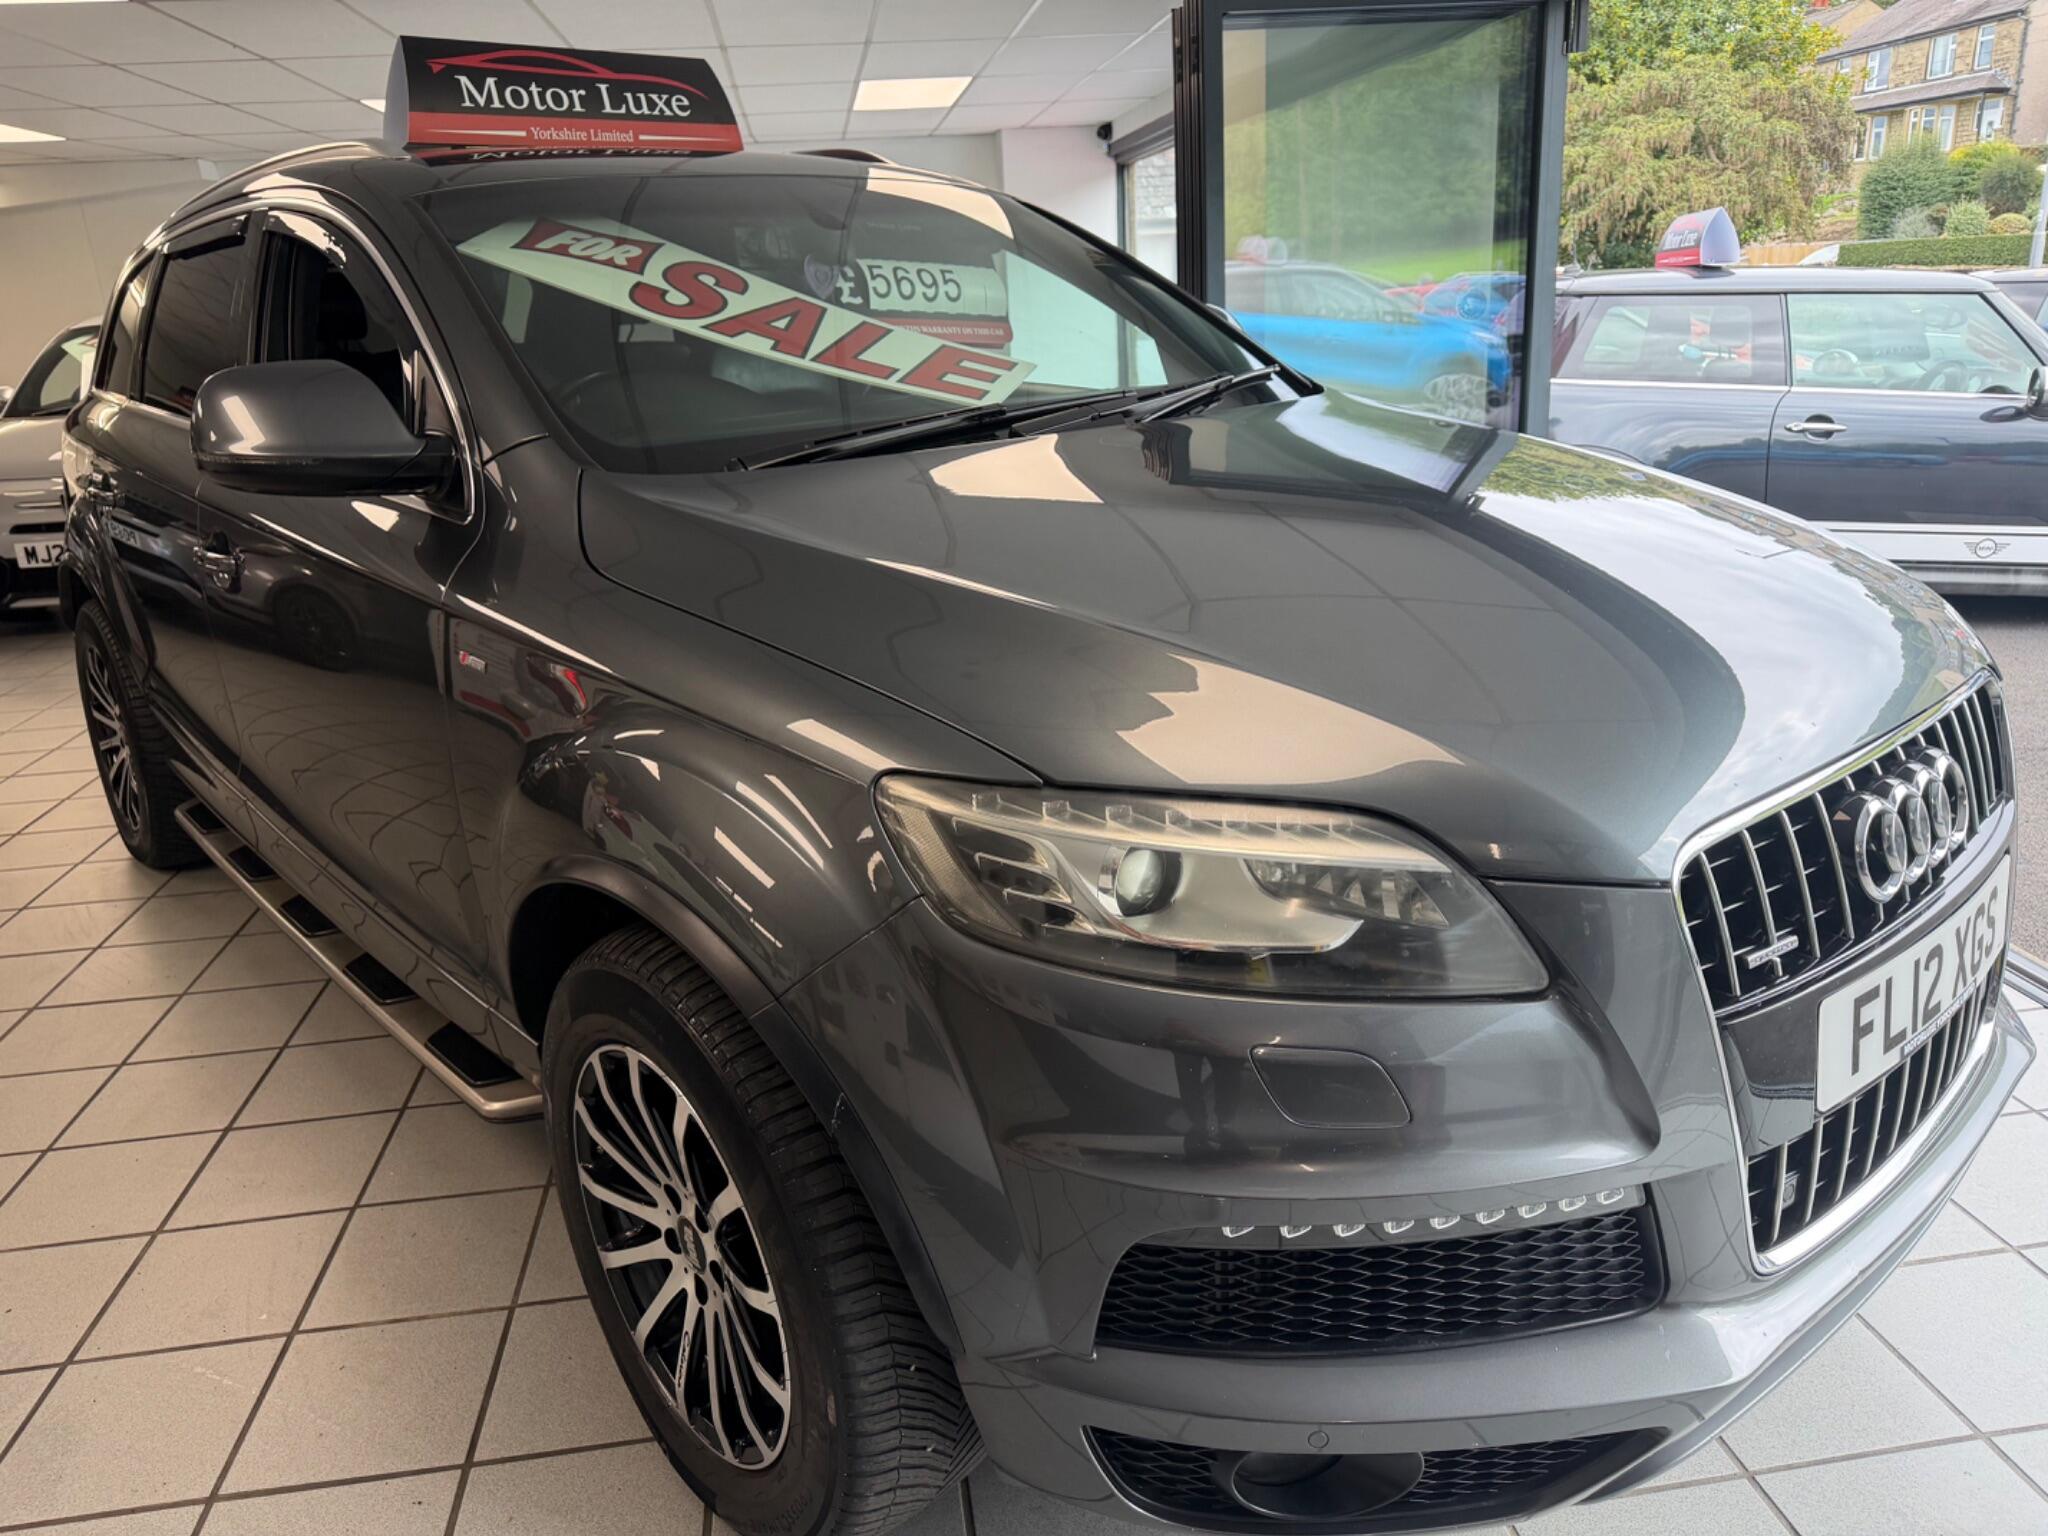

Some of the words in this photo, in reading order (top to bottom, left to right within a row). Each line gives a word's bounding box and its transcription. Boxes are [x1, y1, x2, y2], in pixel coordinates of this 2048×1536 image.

[454, 74, 586, 114] Motor
[595, 83, 692, 117] Luxe
[530, 126, 588, 142] Yorkshire
[590, 128, 634, 143] Limited
[835, 263, 962, 304] £5695
[540, 229, 643, 268] FOR
[629, 260, 1015, 400] SALE
[1851, 943, 1944, 1076] FL12
[1952, 886, 1998, 999] XGS
